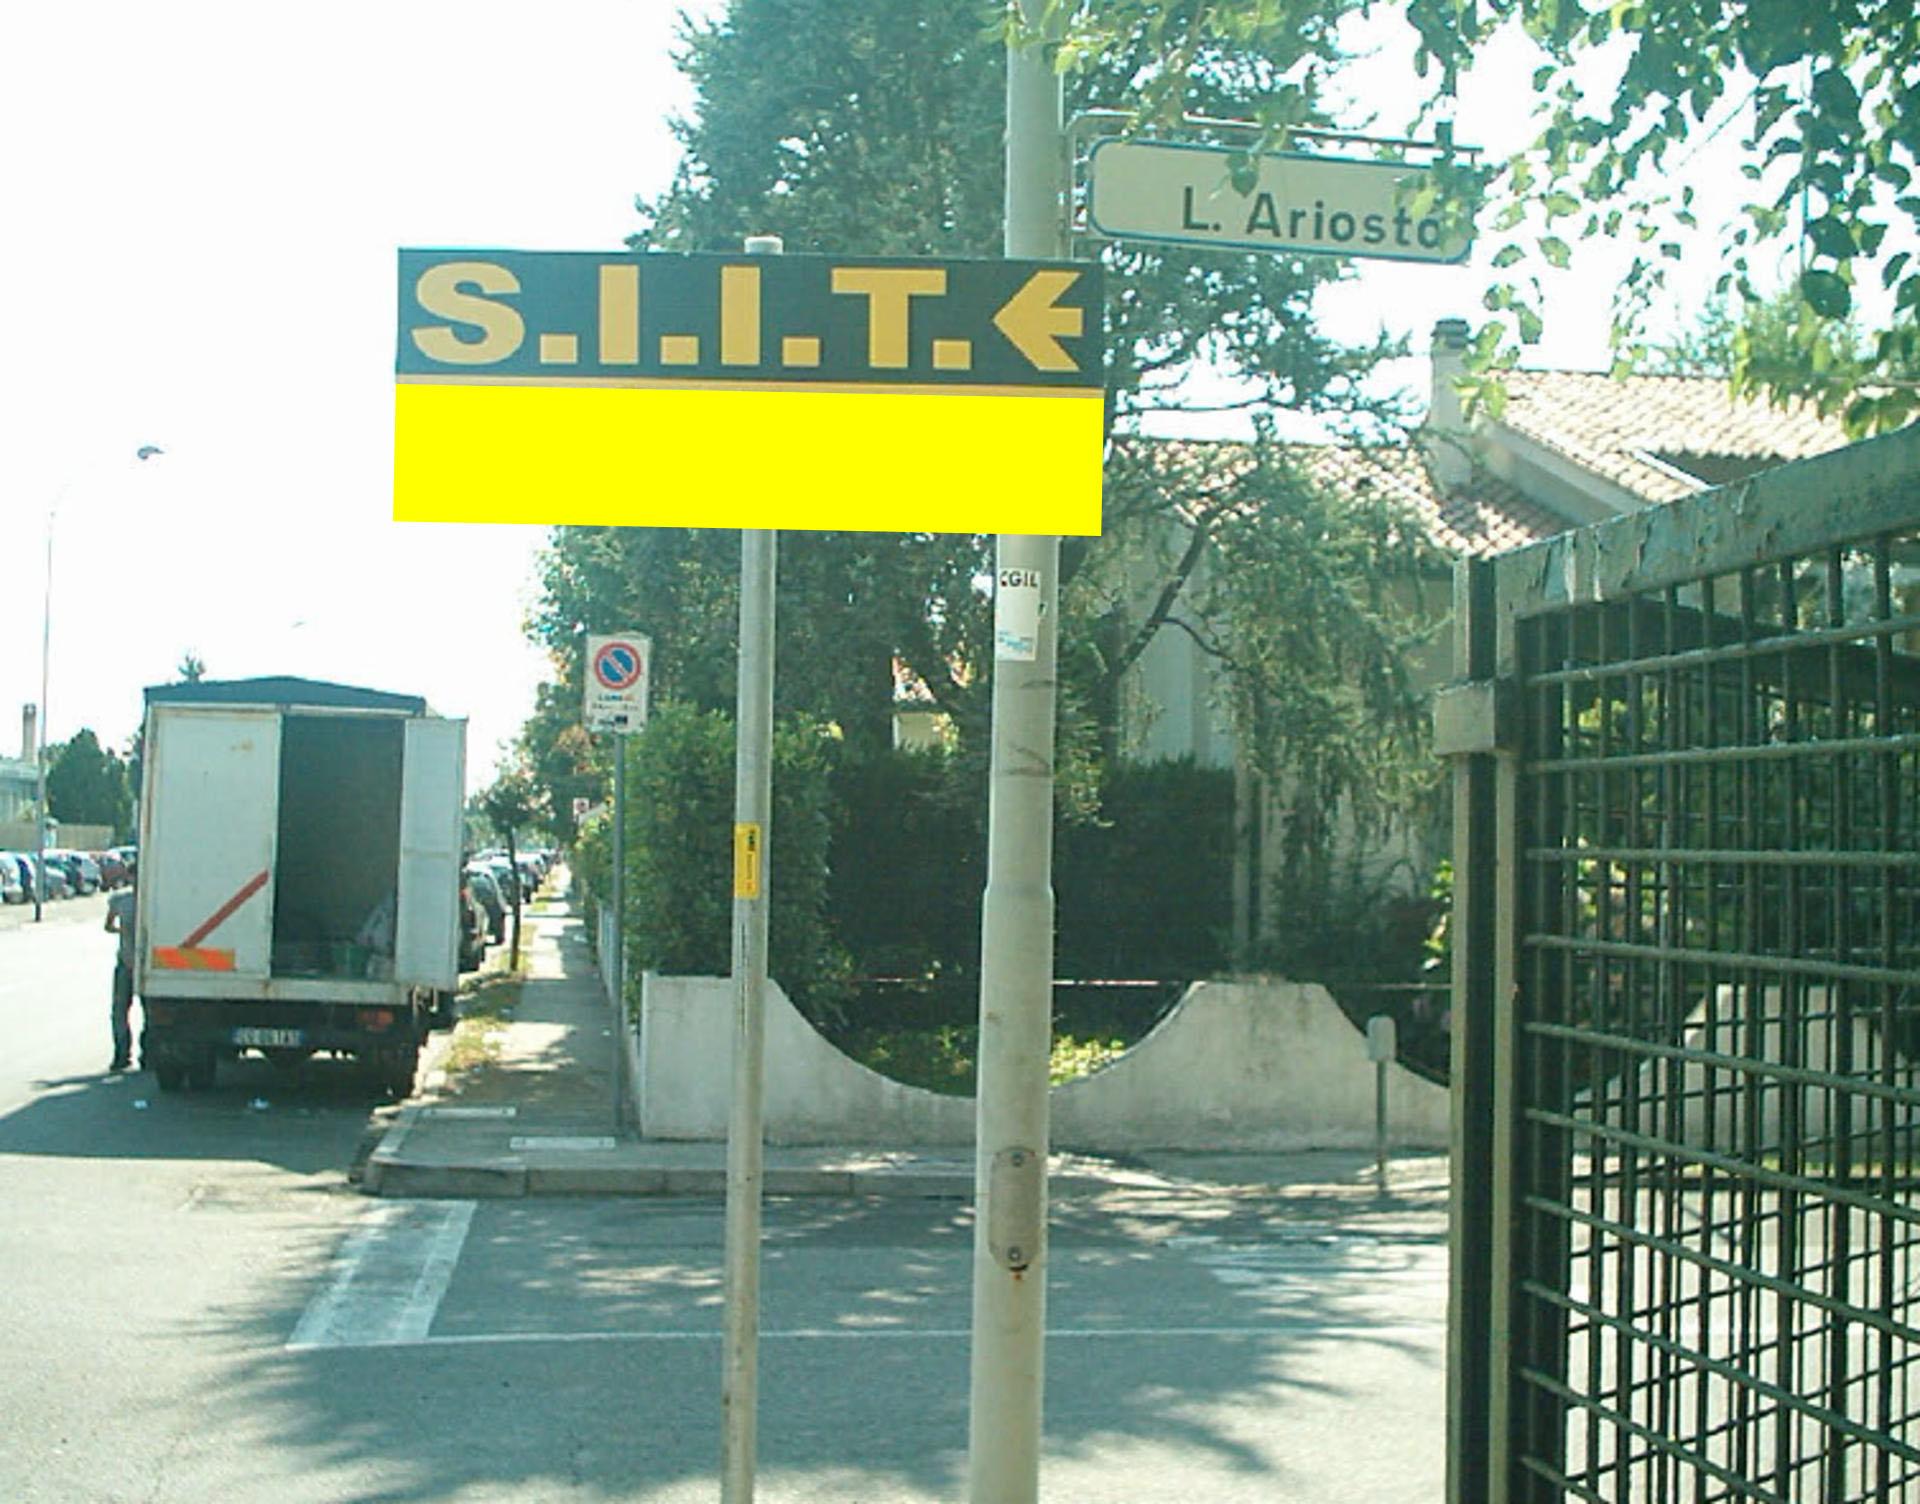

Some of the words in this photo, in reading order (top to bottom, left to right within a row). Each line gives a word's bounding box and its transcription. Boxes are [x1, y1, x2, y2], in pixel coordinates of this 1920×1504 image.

[1181, 185, 1222, 233] L.
[1245, 192, 1444, 250] Ariosto
[411, 261, 973, 371] S.I.I.T.
